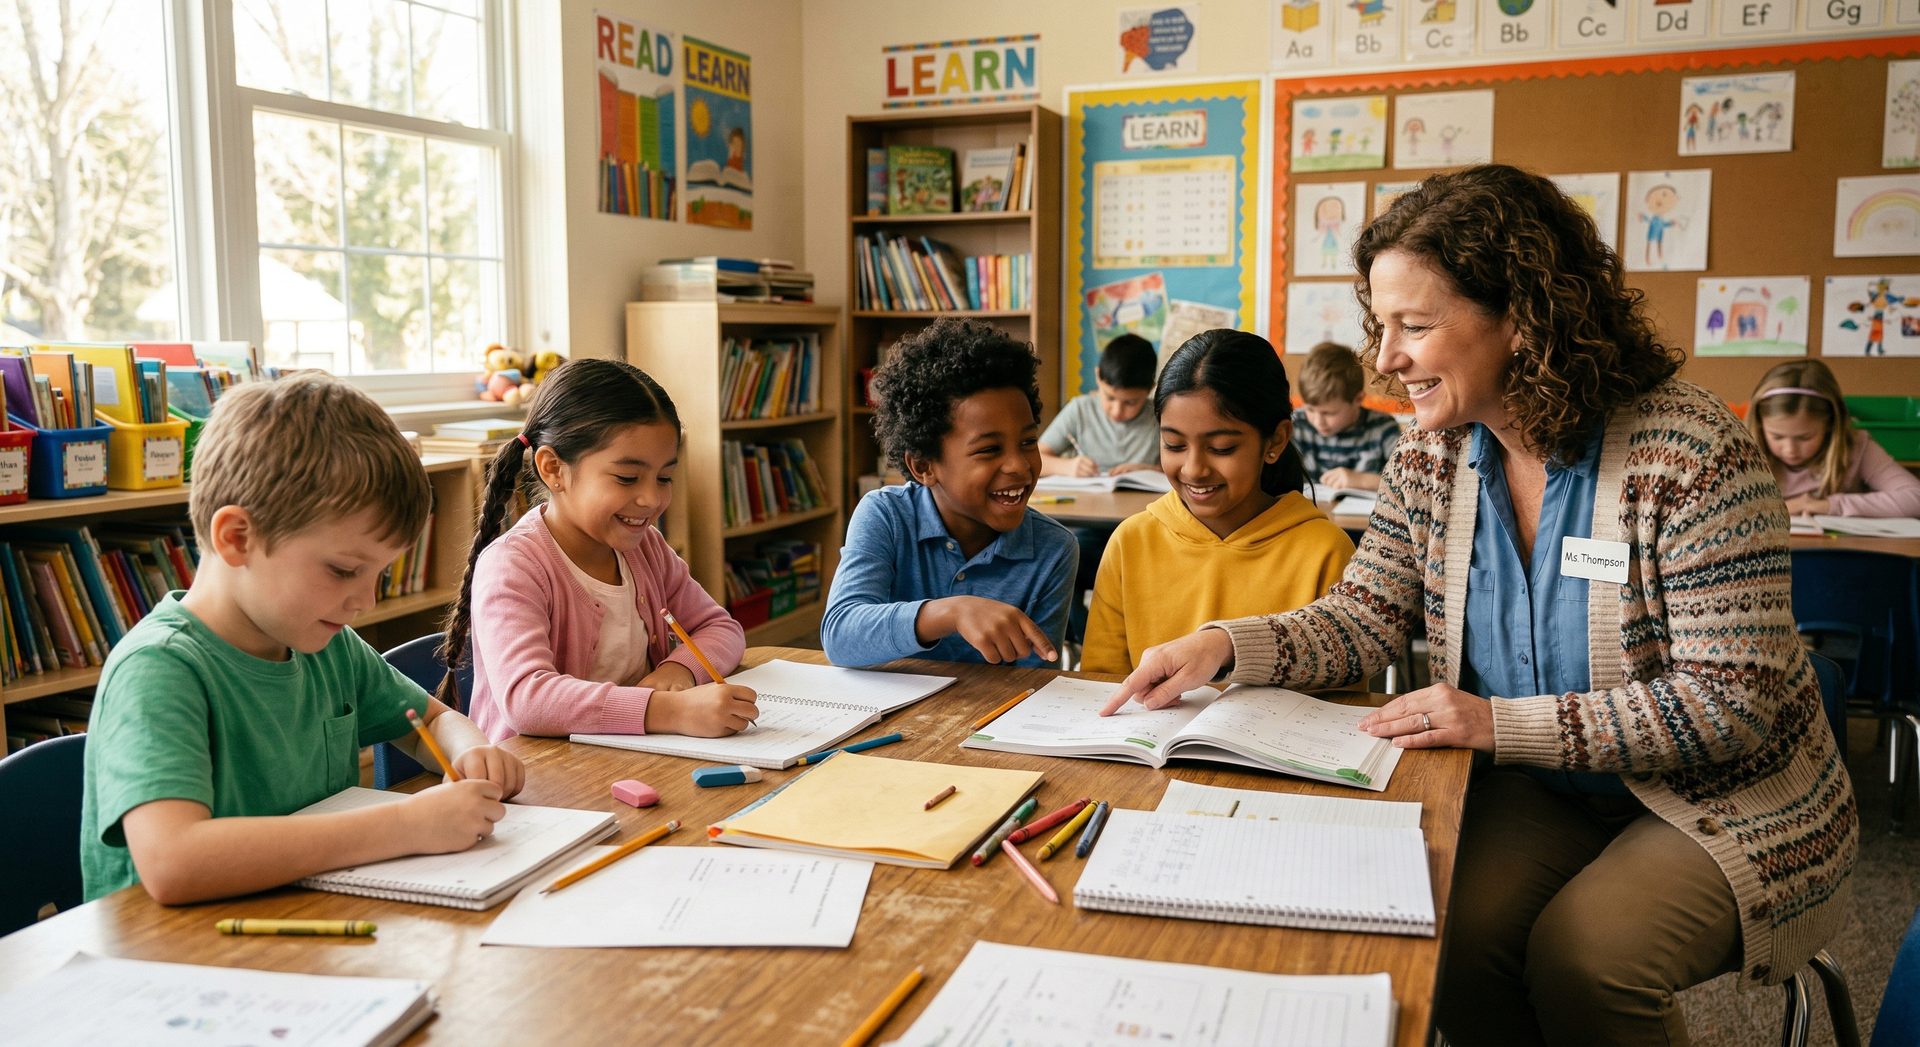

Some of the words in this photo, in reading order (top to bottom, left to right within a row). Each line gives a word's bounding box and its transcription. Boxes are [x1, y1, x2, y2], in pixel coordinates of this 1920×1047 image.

[1656, 10, 1688, 31] Dd
[1742, 4, 1772, 26] Ef
[1826, 0, 1861, 25] Gg
[1499, 23, 1528, 43] Bb
[1577, 16, 1607, 37] Cc
[597, 15, 673, 76] READ
[1286, 40, 1312, 58] Aa
[1355, 35, 1382, 54] Bb
[1425, 29, 1454, 49] Cc
[684, 45, 750, 95] LEARN
[886, 47, 1035, 98] LEARN
[1130, 119, 1199, 142] LEARN
[1564, 551, 1580, 563] Ms.
[1580, 553, 1625, 568] Thompson
